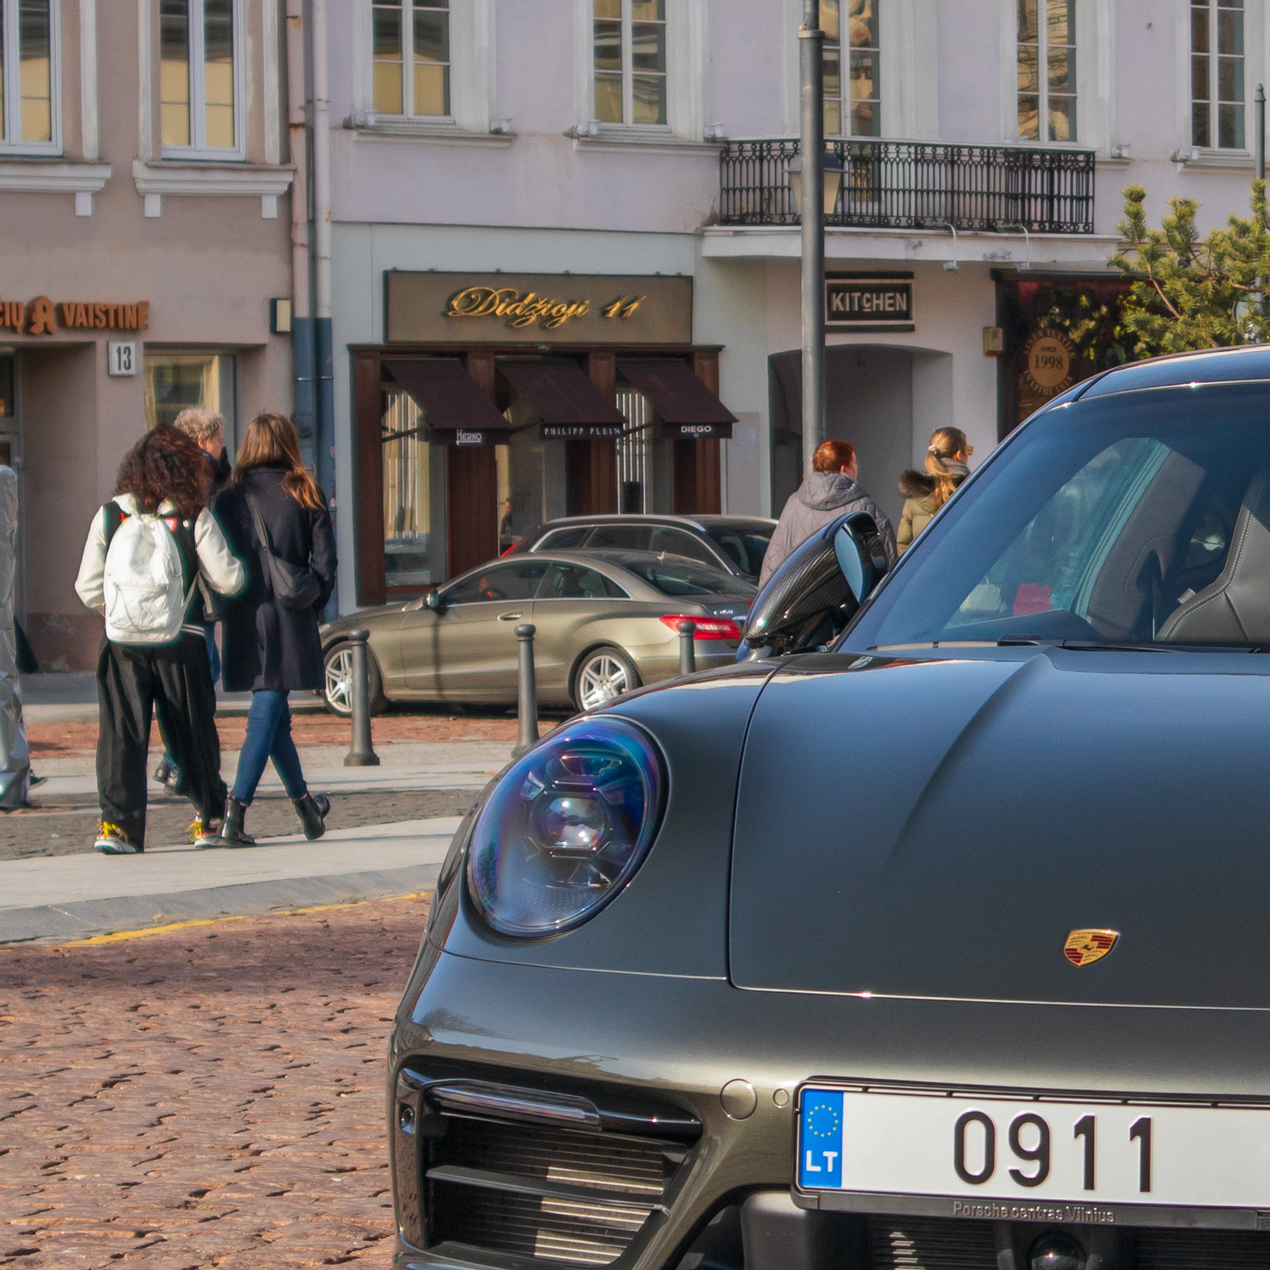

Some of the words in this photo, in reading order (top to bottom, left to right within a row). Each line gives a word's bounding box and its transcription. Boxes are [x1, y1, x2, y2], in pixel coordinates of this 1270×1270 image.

[604, 295, 647, 318] 11
[832, 292, 907, 312] KITCHEN
[115, 345, 132, 371] 13
[1034, 355, 1063, 370] 1998
[456, 429, 482, 443] HERNO
[544, 427, 583, 435] PHILIPP
[589, 427, 620, 435] PLEIN
[680, 425, 712, 433] DIEGO
[805, 1150, 838, 1173] LT
[953, 1110, 1152, 1193] 0911
[953, 1201, 1009, 1219] Porsche
[1011, 1206, 1064, 1221] centras
[1066, 1205, 1116, 1223] Vilnius
